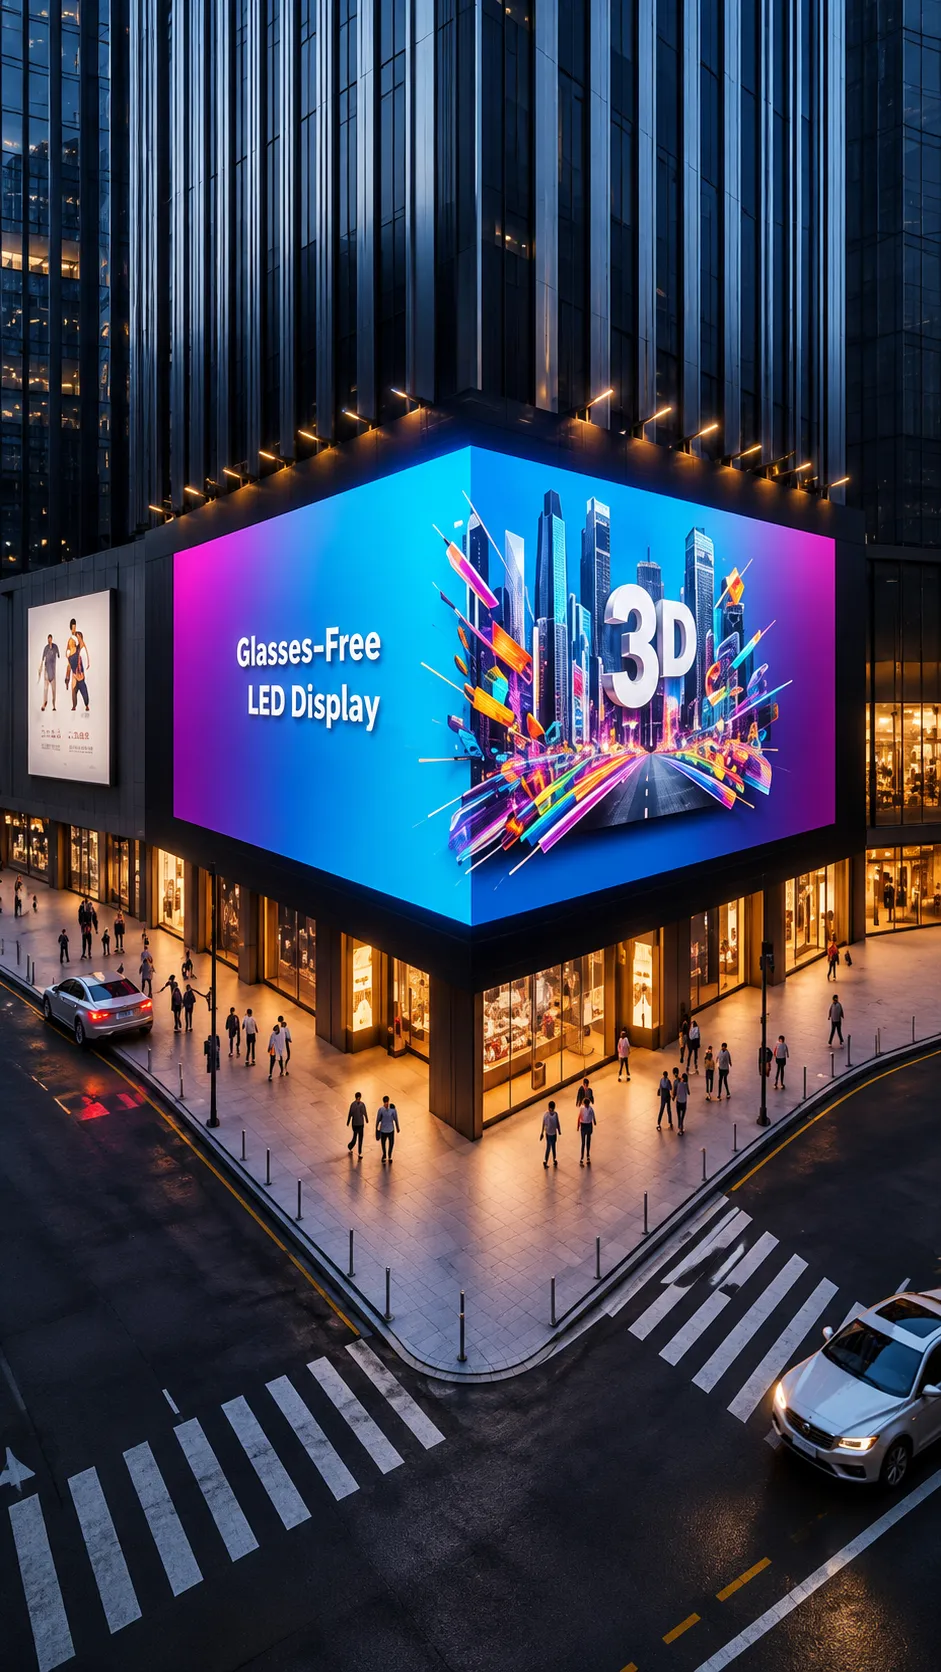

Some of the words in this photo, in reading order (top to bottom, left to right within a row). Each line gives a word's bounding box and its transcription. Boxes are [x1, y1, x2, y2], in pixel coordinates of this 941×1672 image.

[236, 627, 381, 667] Glasses-Free
[602, 584, 697, 709] 3D
[248, 685, 286, 716] LED
[291, 684, 381, 732] Display
